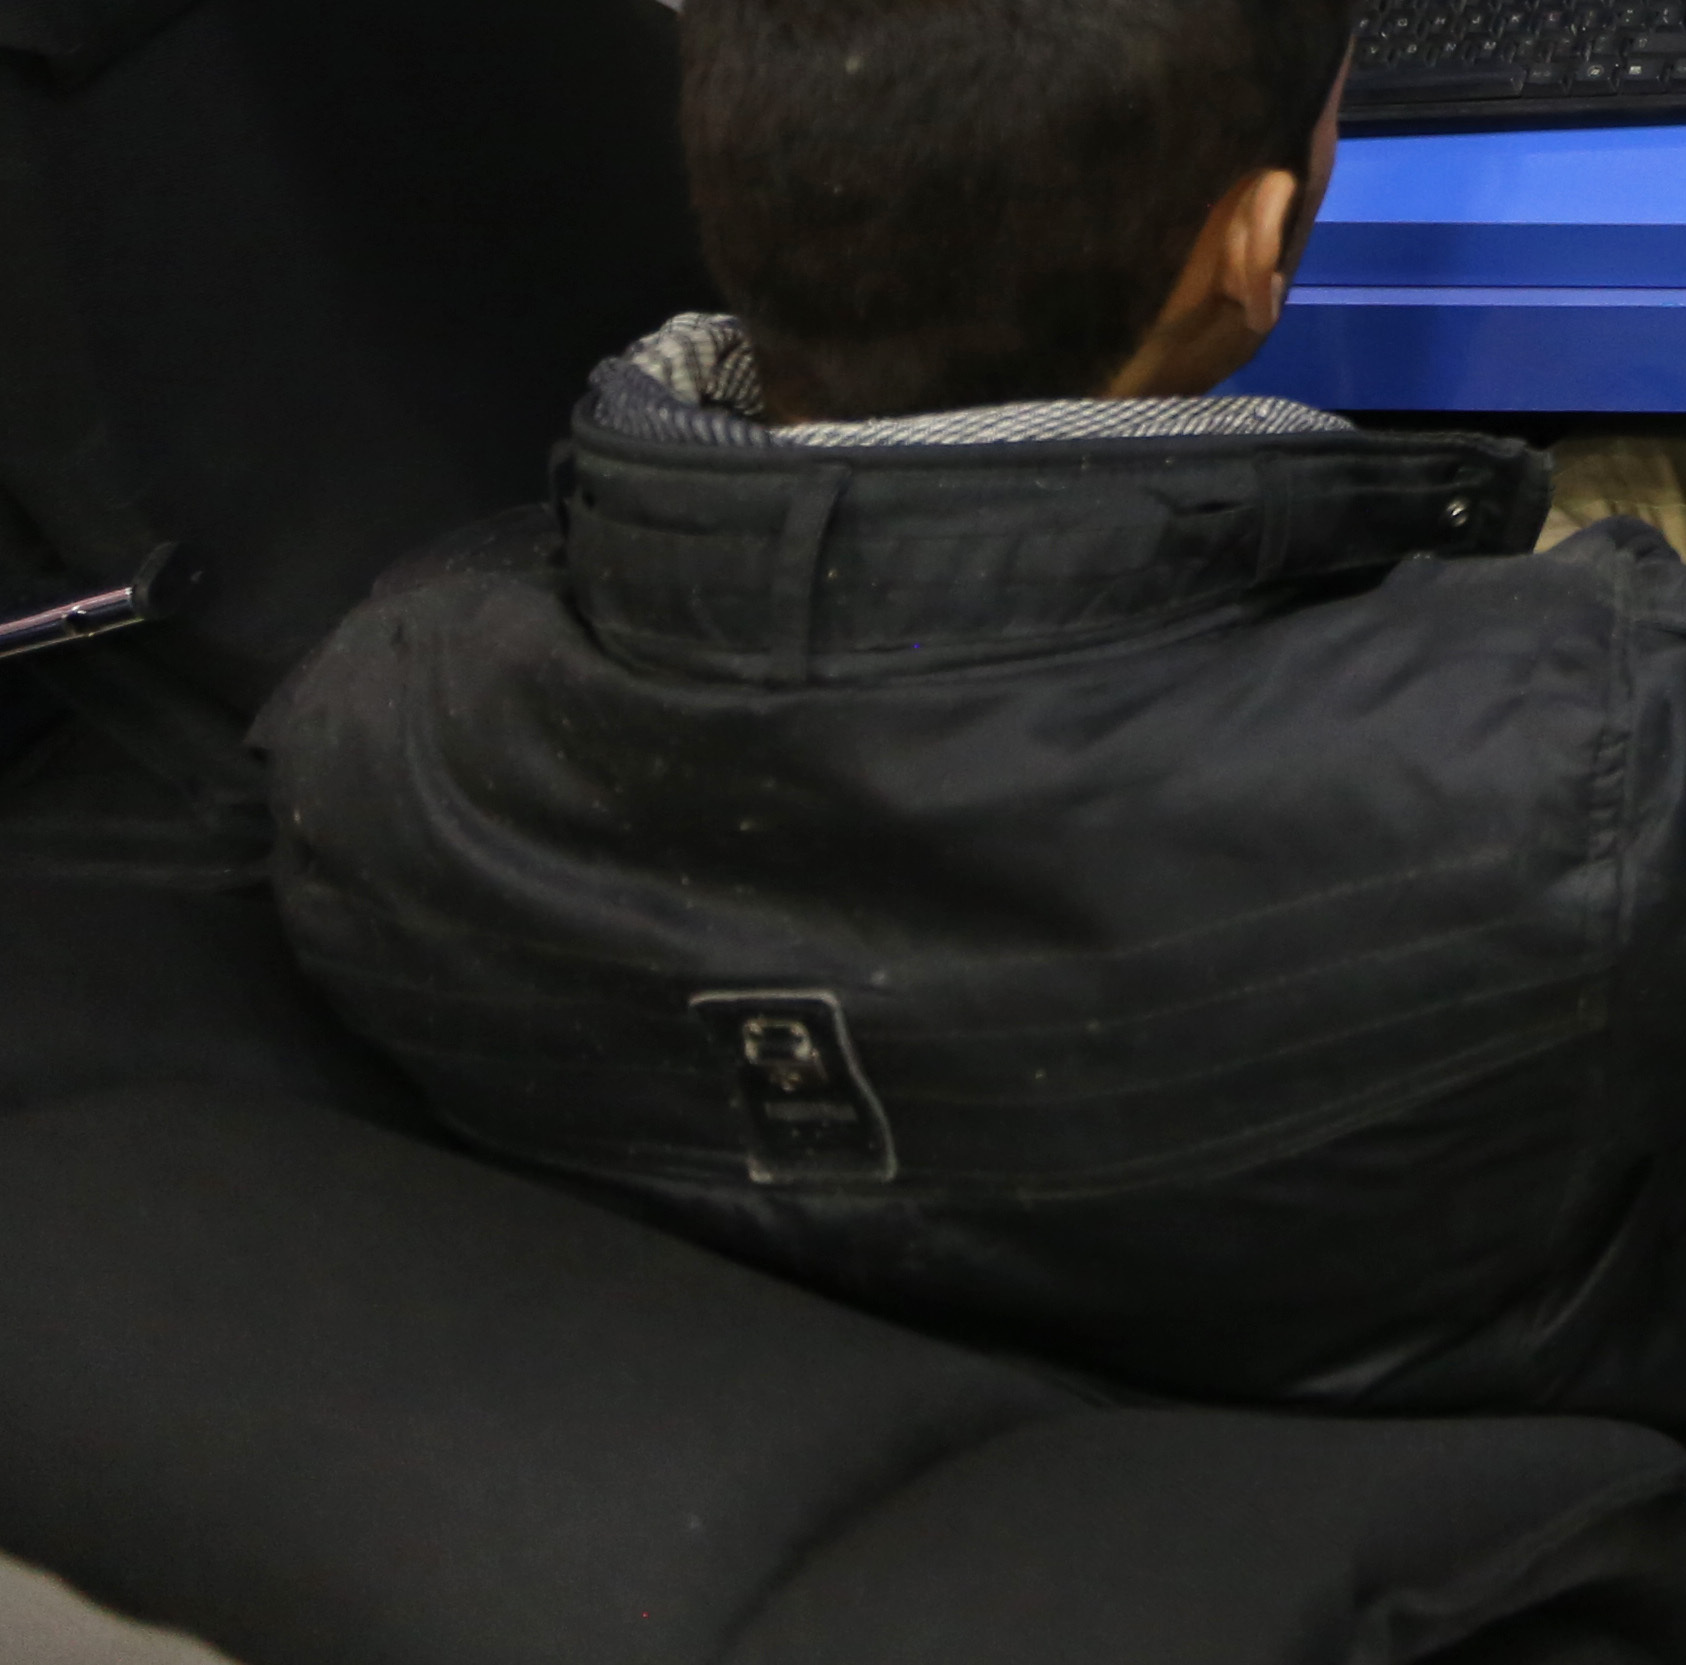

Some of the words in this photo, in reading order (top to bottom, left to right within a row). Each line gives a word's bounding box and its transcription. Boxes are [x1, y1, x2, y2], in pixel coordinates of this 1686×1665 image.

[1472, 15, 1481, 24] J
[1511, 14, 1521, 22] K
[1446, 42, 1456, 51] N
[1483, 41, 1497, 50] M
